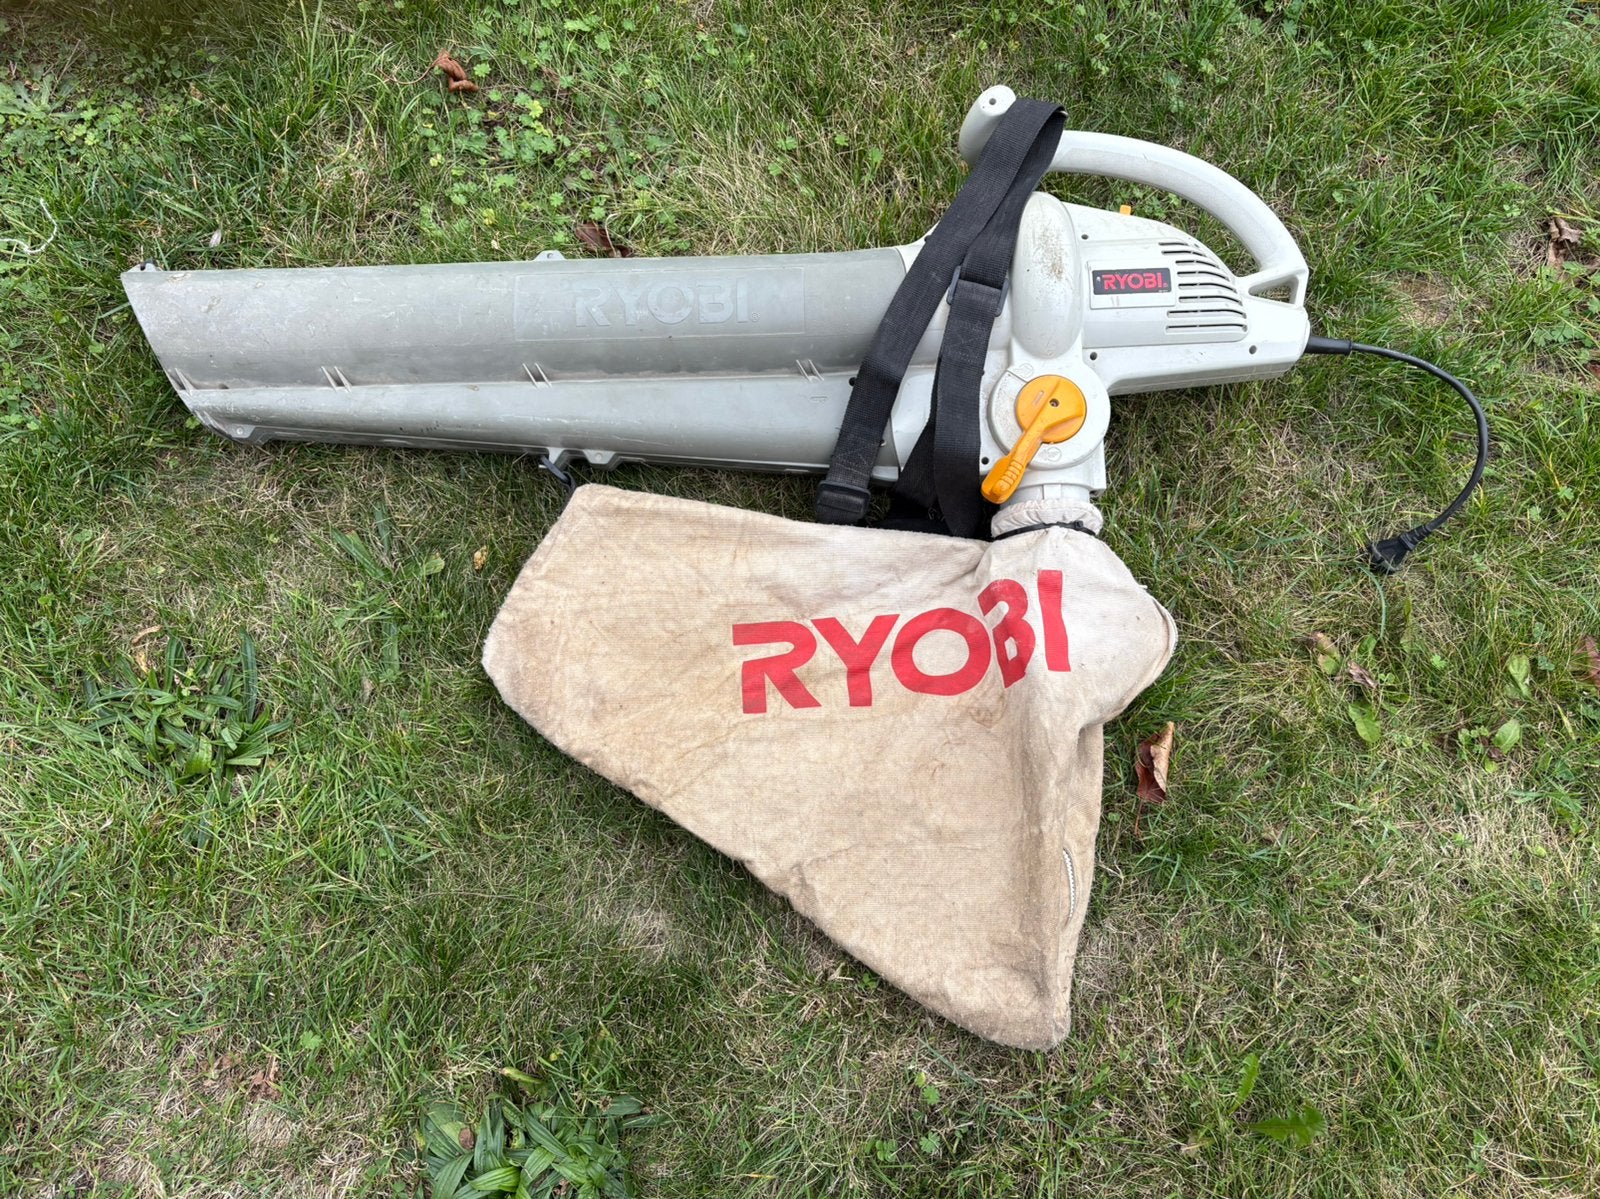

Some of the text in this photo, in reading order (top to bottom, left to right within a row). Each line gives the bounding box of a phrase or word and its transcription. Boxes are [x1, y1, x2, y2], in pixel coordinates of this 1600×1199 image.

[571, 277, 748, 326] RYOBI
[1102, 272, 1163, 290] RYOBI
[733, 570, 1071, 713] RYOBI
